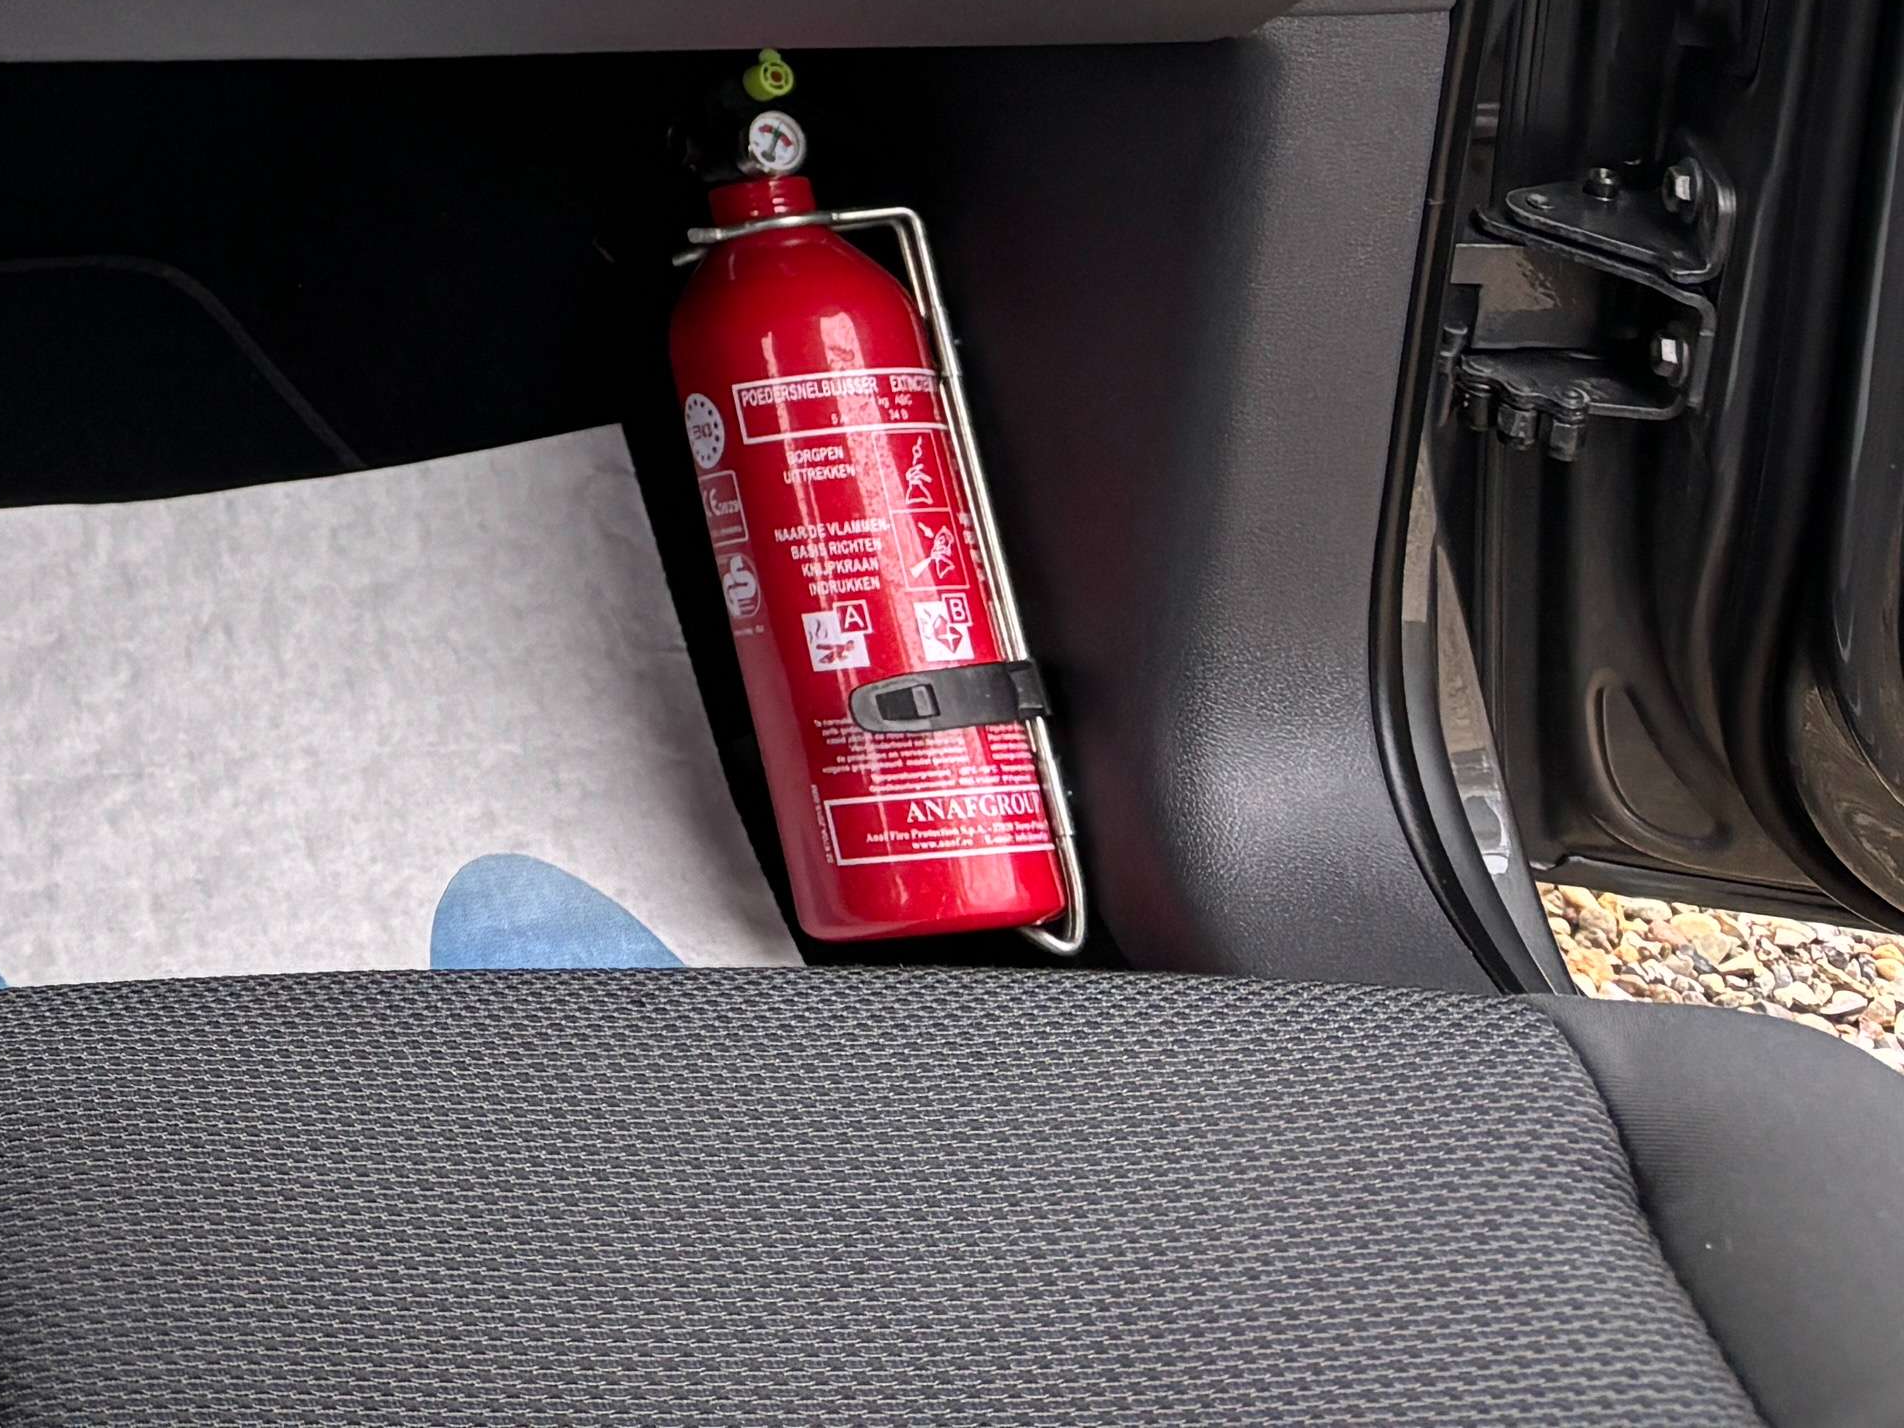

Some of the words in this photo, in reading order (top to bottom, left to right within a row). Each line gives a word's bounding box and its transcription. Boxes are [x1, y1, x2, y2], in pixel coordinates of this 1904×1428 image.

[786, 446, 844, 466] BORGPEN
[774, 525, 808, 543] NAAR
[807, 523, 827, 540] DE
[828, 538, 882, 556] RICHTEN
[808, 575, 881, 597] INDRUKKEN
[952, 598, 968, 621] B
[844, 610, 864, 630] A
